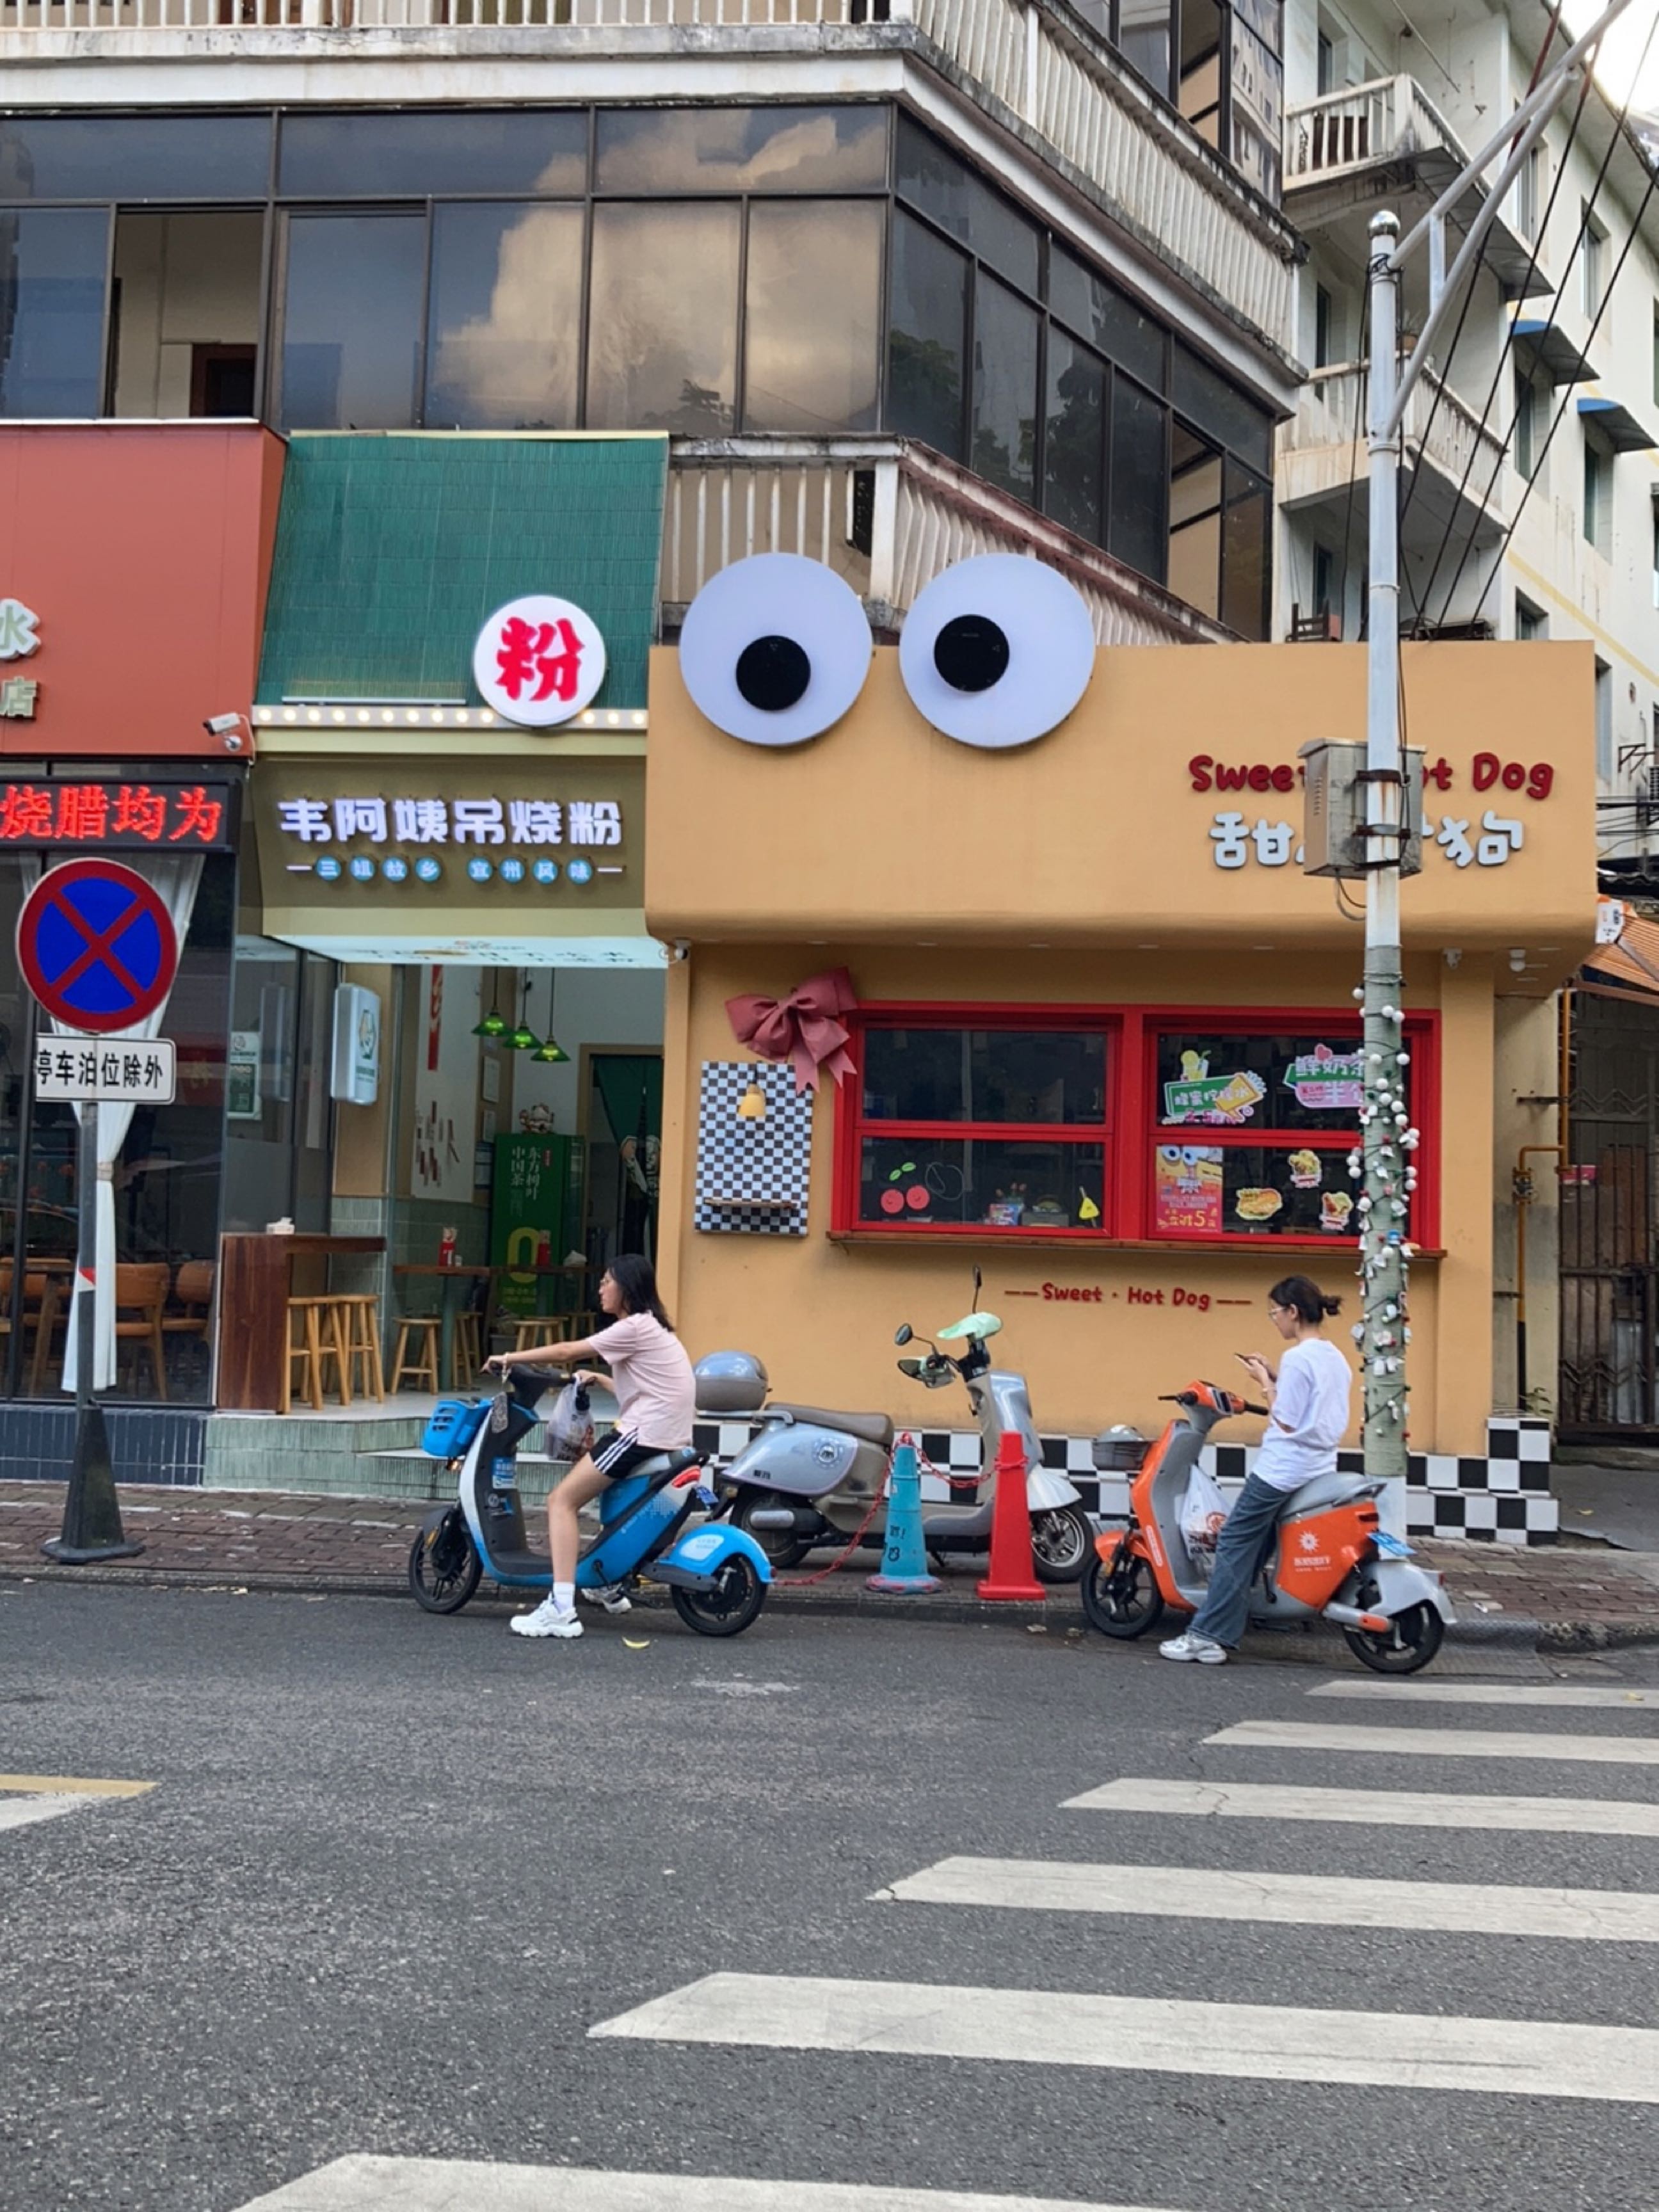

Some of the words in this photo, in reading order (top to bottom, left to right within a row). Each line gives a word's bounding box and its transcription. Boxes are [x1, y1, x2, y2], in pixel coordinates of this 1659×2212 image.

[495, 616, 585, 701] 粉
[1189, 755, 1305, 792] Swee
[1473, 752, 1554, 800] Dog
[0, 785, 222, 842] 烧腊均为
[276, 797, 623, 846] 韦阿姨吊烧粉
[36, 1048, 164, 1090] 停车泊位除外
[1041, 1282, 1103, 1303] Sweet
[1127, 1286, 1165, 1306] Hot
[1172, 1286, 1212, 1311] Dog
